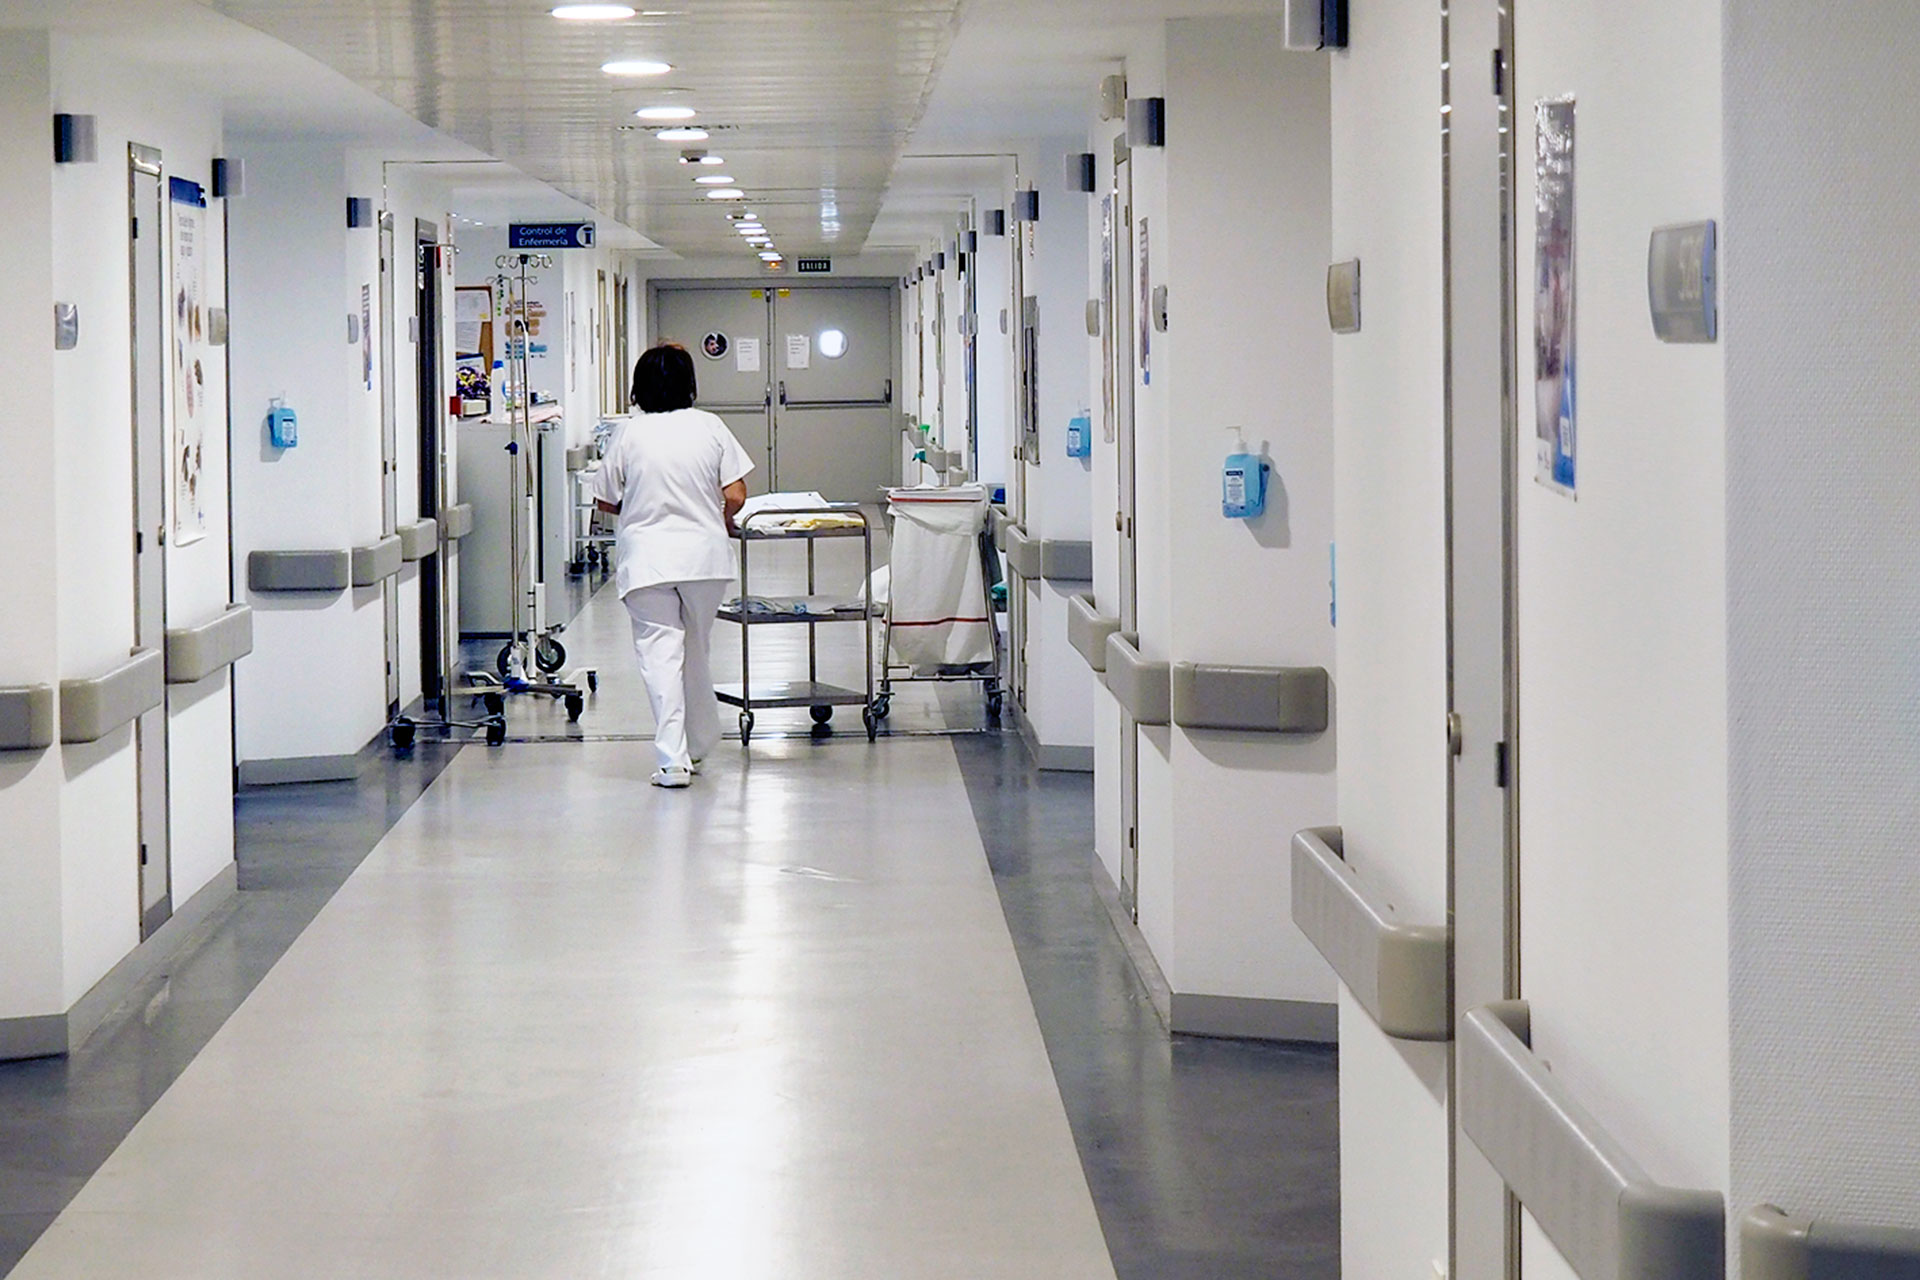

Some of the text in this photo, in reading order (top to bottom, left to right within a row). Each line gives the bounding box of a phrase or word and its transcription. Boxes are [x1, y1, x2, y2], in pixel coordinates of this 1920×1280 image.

[519, 227, 567, 236] Control de
[519, 237, 568, 246] Enfermería
[801, 262, 828, 270] SALIDA
